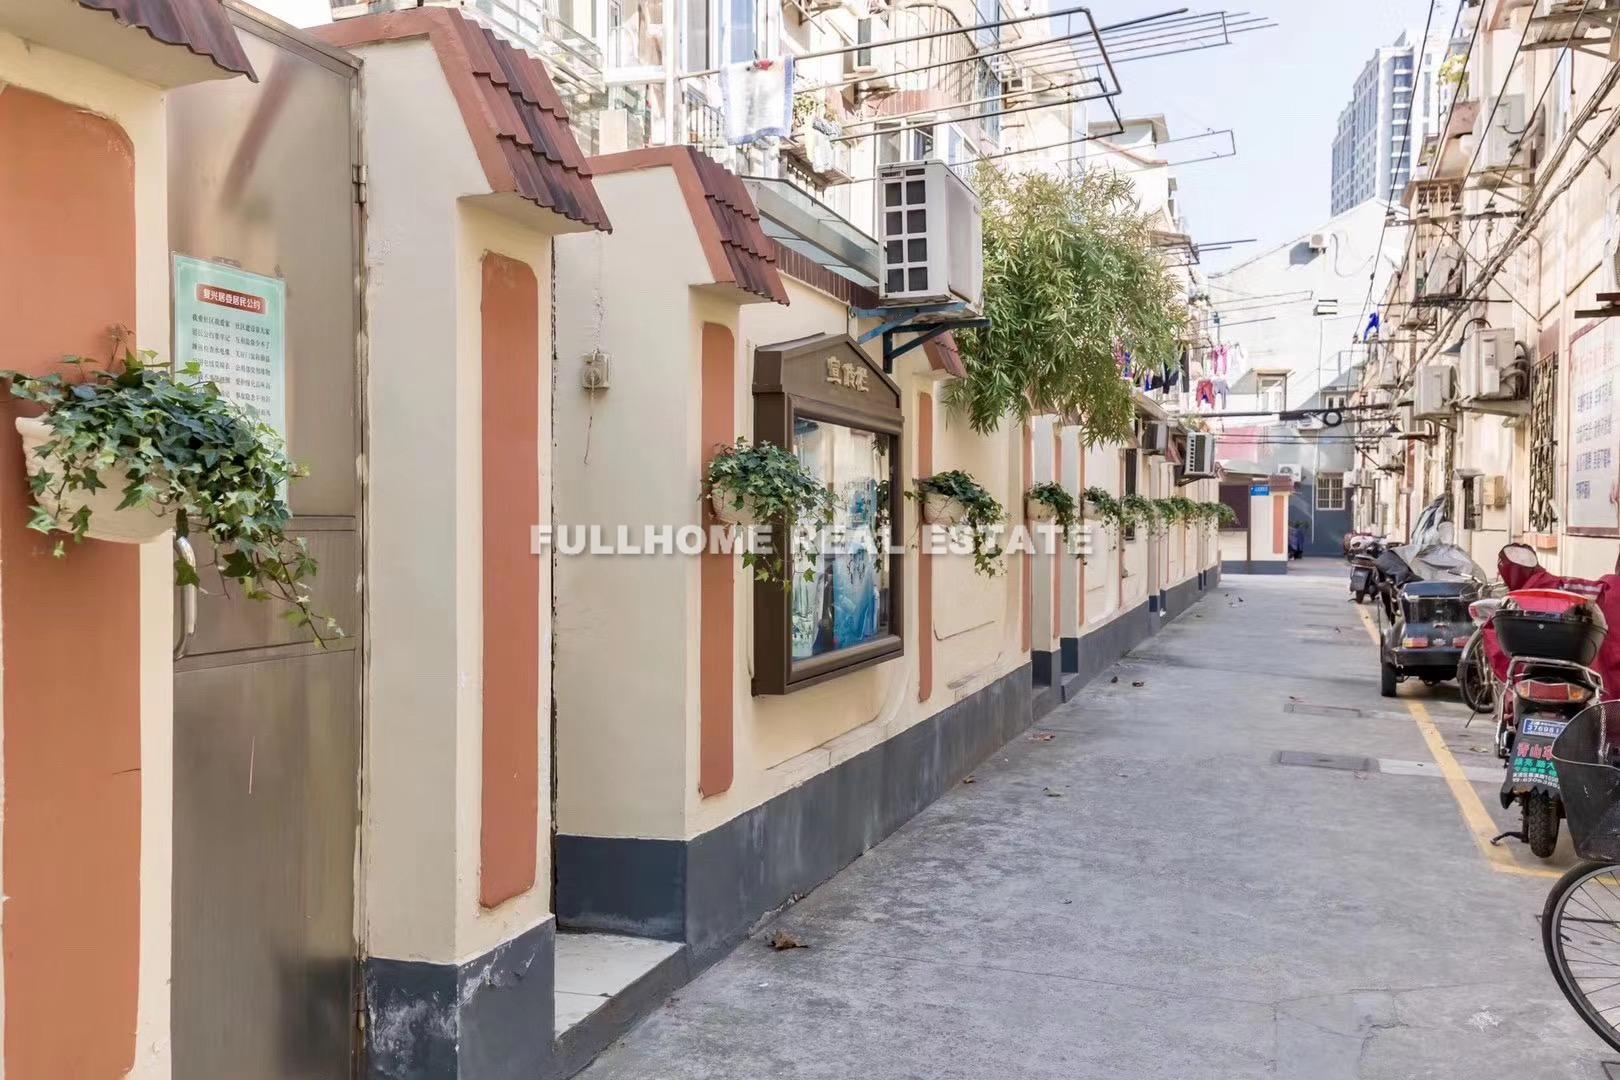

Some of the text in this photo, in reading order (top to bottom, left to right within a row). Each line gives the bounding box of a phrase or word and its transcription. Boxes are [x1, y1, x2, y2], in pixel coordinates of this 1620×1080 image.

[203, 288, 261, 311] 复兴居委居民公约
[826, 356, 869, 393] 宣传栏
